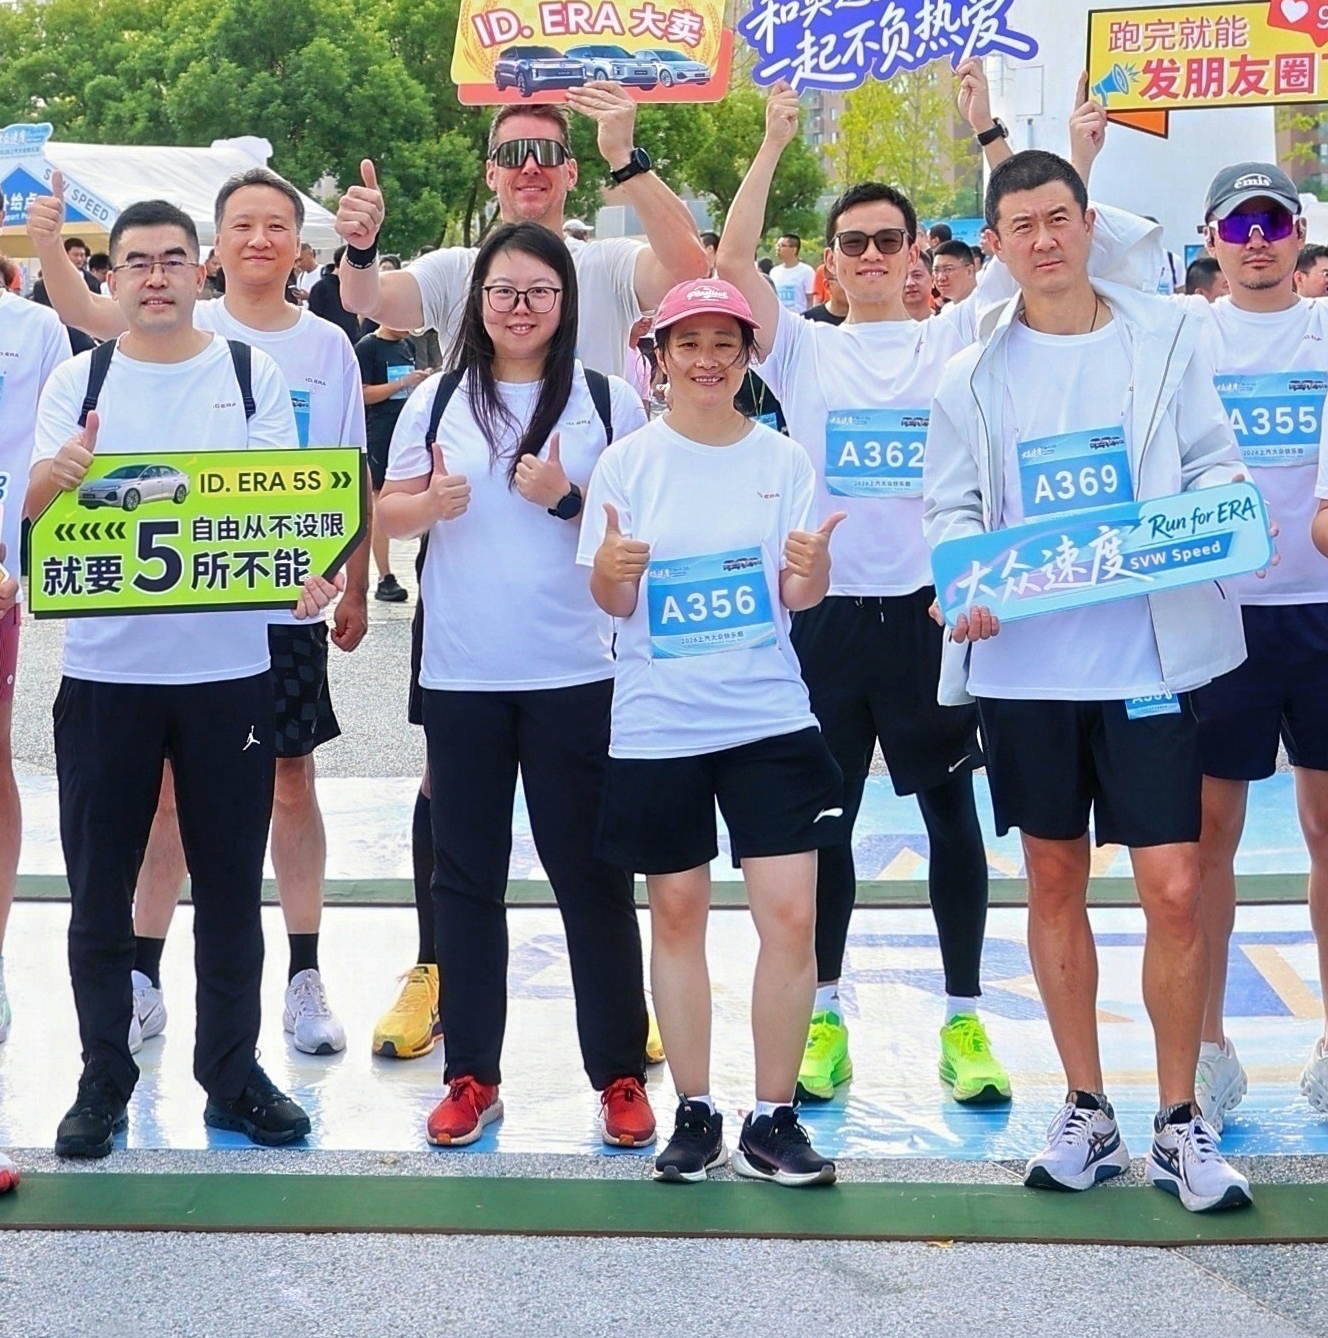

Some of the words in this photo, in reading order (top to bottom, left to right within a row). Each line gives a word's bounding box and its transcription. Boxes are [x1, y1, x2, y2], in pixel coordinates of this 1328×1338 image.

[476, 11, 532, 47] ID.
[541, 2, 624, 37] ERA
[630, 2, 705, 46] 大卖
[1108, 14, 1249, 53] 跑完就能
[71, 188, 109, 222] SPEED
[1229, 406, 1318, 436] A355
[837, 440, 925, 468] A362
[200, 472, 230, 494] ID.
[237, 471, 286, 492] ERA
[292, 470, 322, 491] 5S
[1034, 464, 1118, 504] A369
[191, 512, 345, 543] 自由从不设限
[1147, 513, 1188, 540] Run
[1190, 505, 1214, 535] for
[1217, 496, 1259, 522] ERA
[42, 520, 312, 596] 就要5所不能
[956, 525, 1156, 606] 大众速度
[1129, 551, 1166, 570] SVW
[1172, 540, 1222, 563] Speed
[660, 585, 756, 625] A356
[680, 630, 745, 645] 2026上汽大众快乐跑
